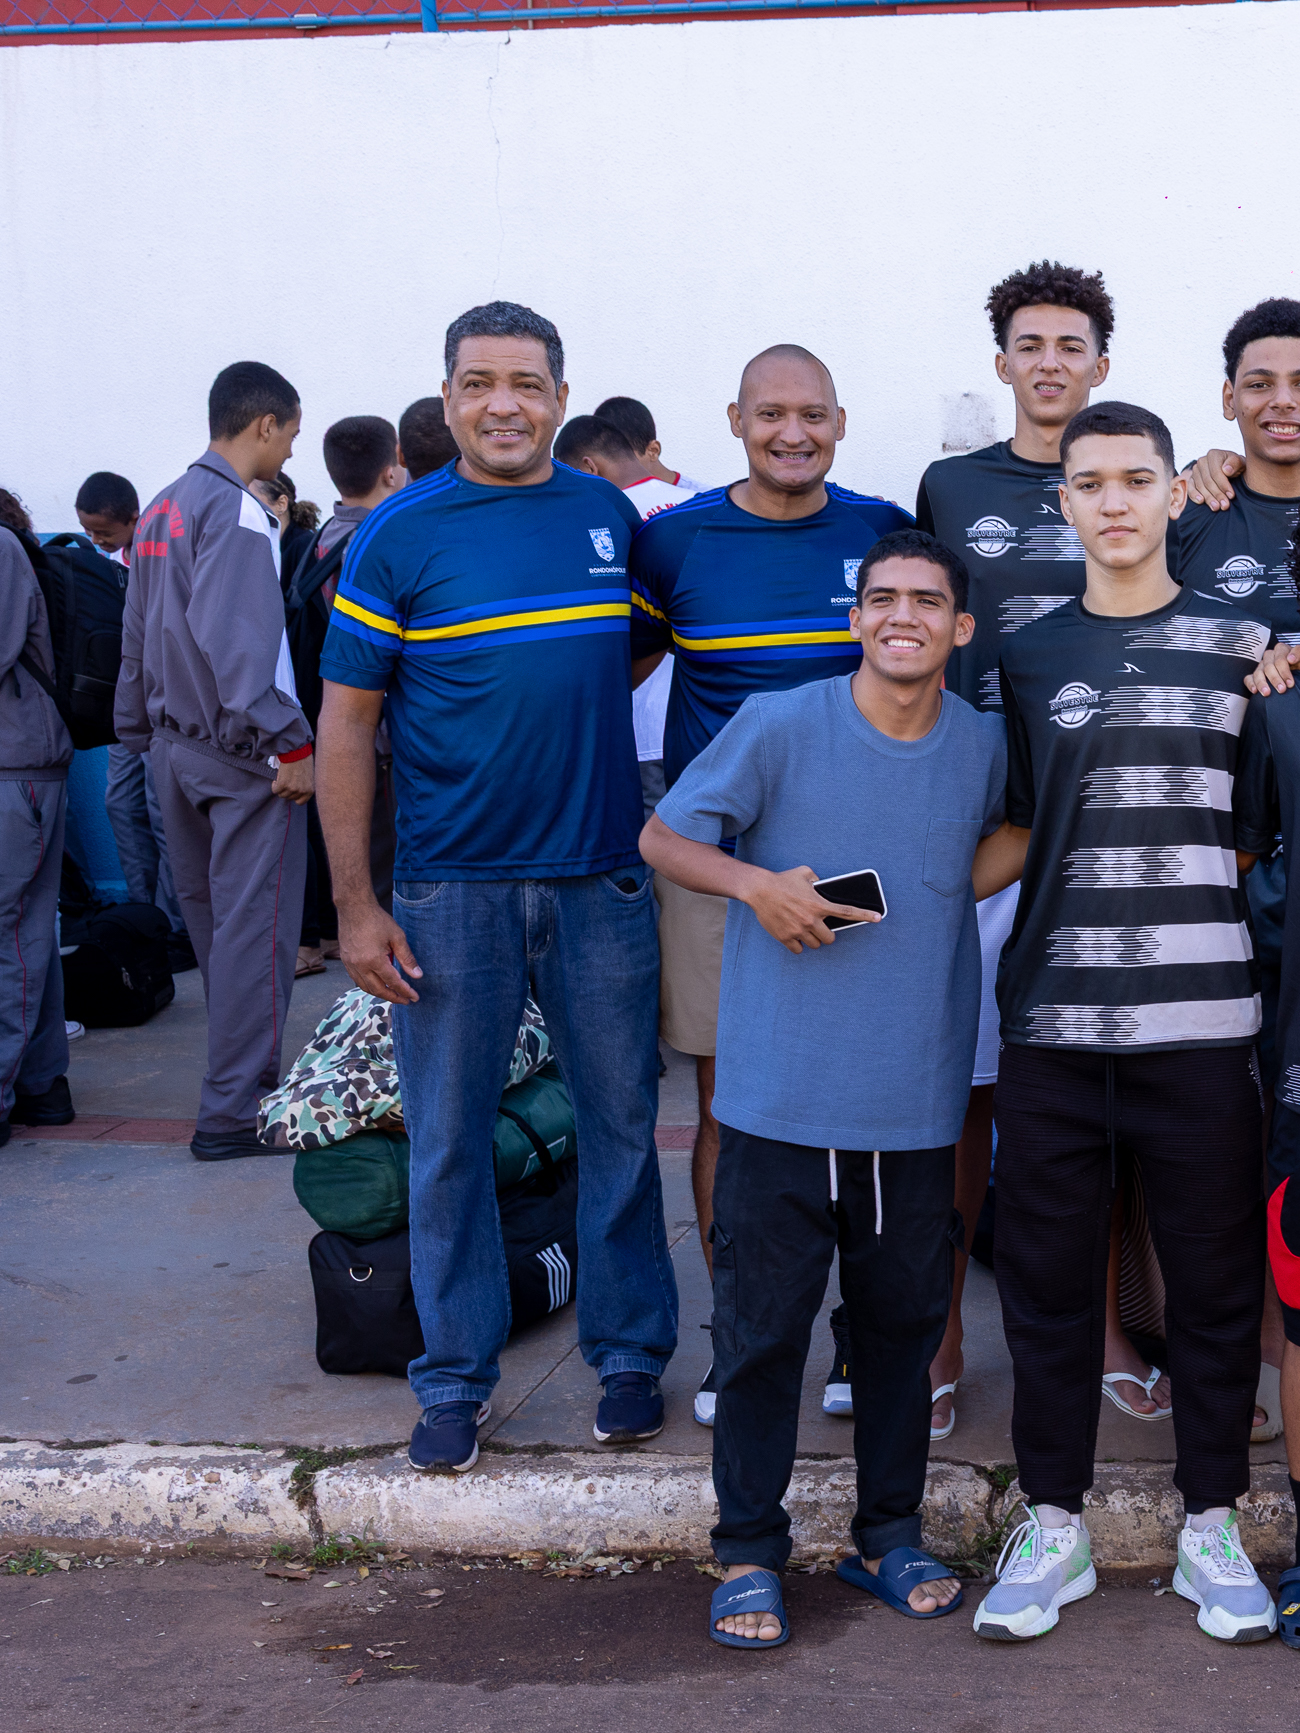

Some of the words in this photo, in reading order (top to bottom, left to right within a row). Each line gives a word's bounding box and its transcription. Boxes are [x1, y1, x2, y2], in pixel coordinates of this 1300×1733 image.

[967, 529, 1016, 537] SILVESTRE
[588, 566, 626, 574] RONDONÓPOLI
[1217, 567, 1264, 578] SILVESTRE
[1050, 694, 1099, 710] SILVESTRE
[728, 1589, 771, 1602] rider
